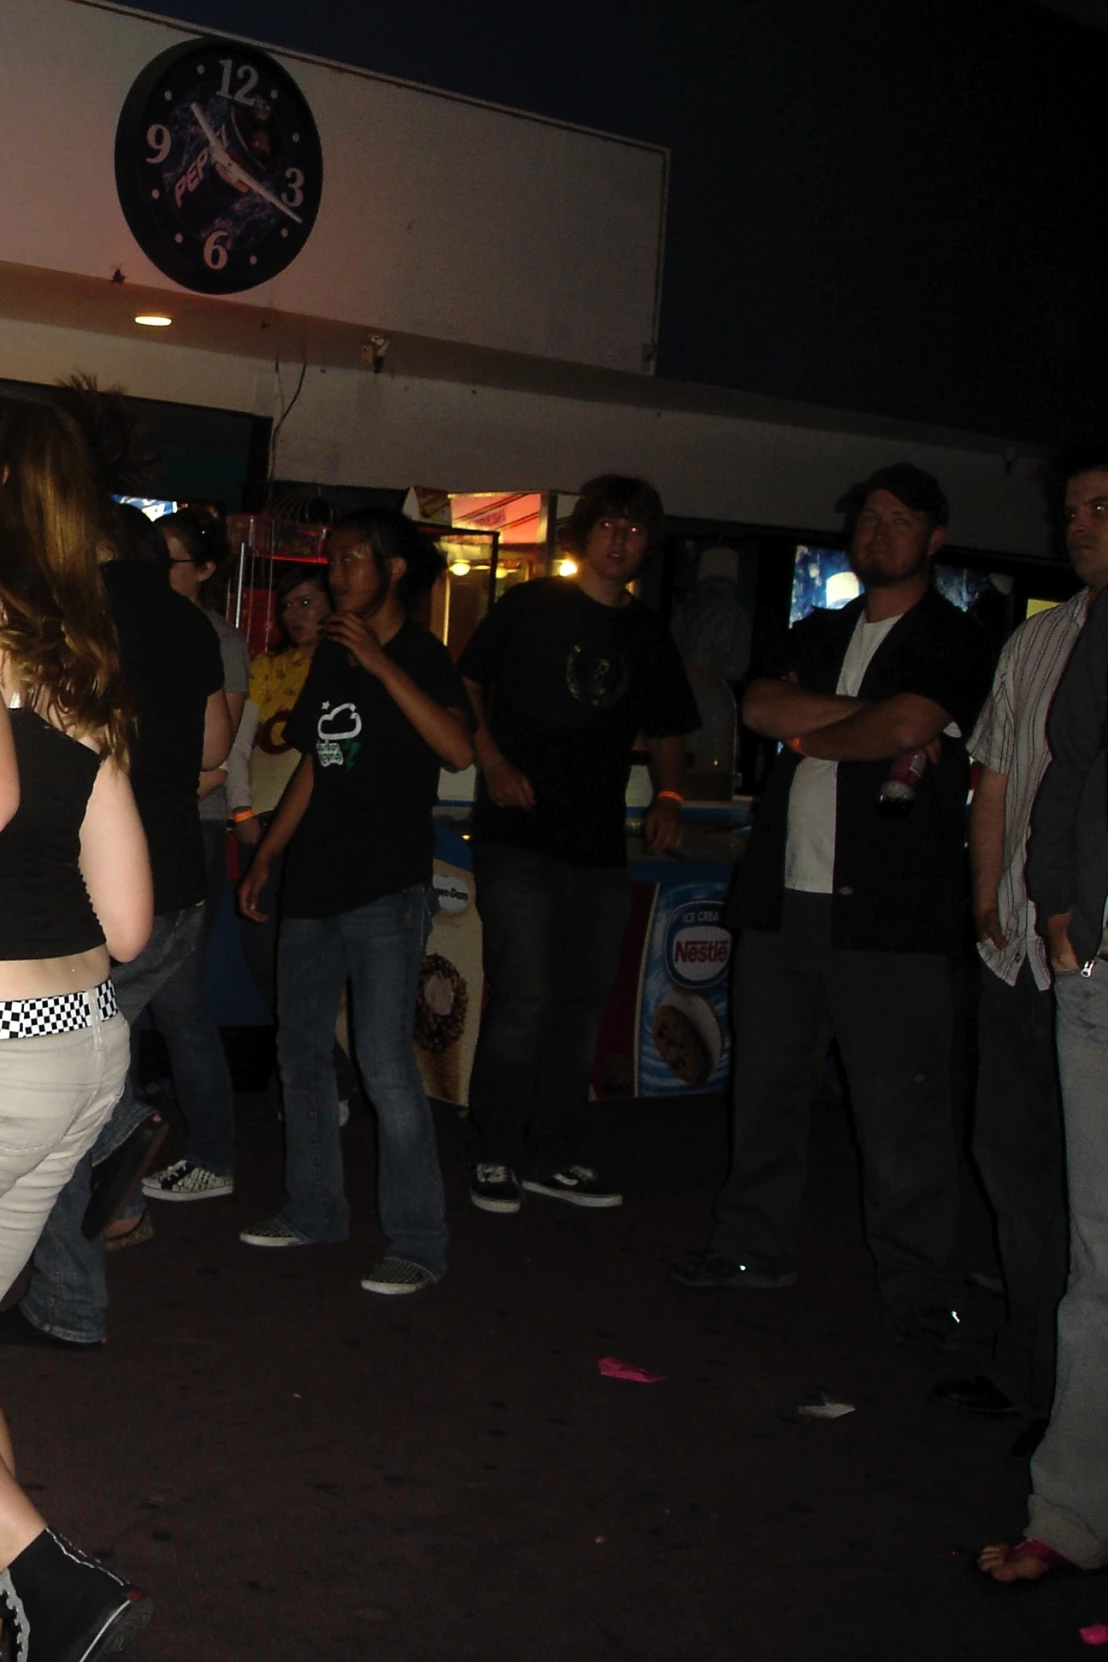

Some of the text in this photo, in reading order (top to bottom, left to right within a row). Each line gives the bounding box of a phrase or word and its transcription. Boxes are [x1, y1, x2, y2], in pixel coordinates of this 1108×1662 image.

[215, 58, 259, 107] 12
[146, 124, 173, 165] 9
[280, 168, 306, 208] 3
[203, 230, 229, 271] 6
[682, 910, 720, 923] ICE CREA
